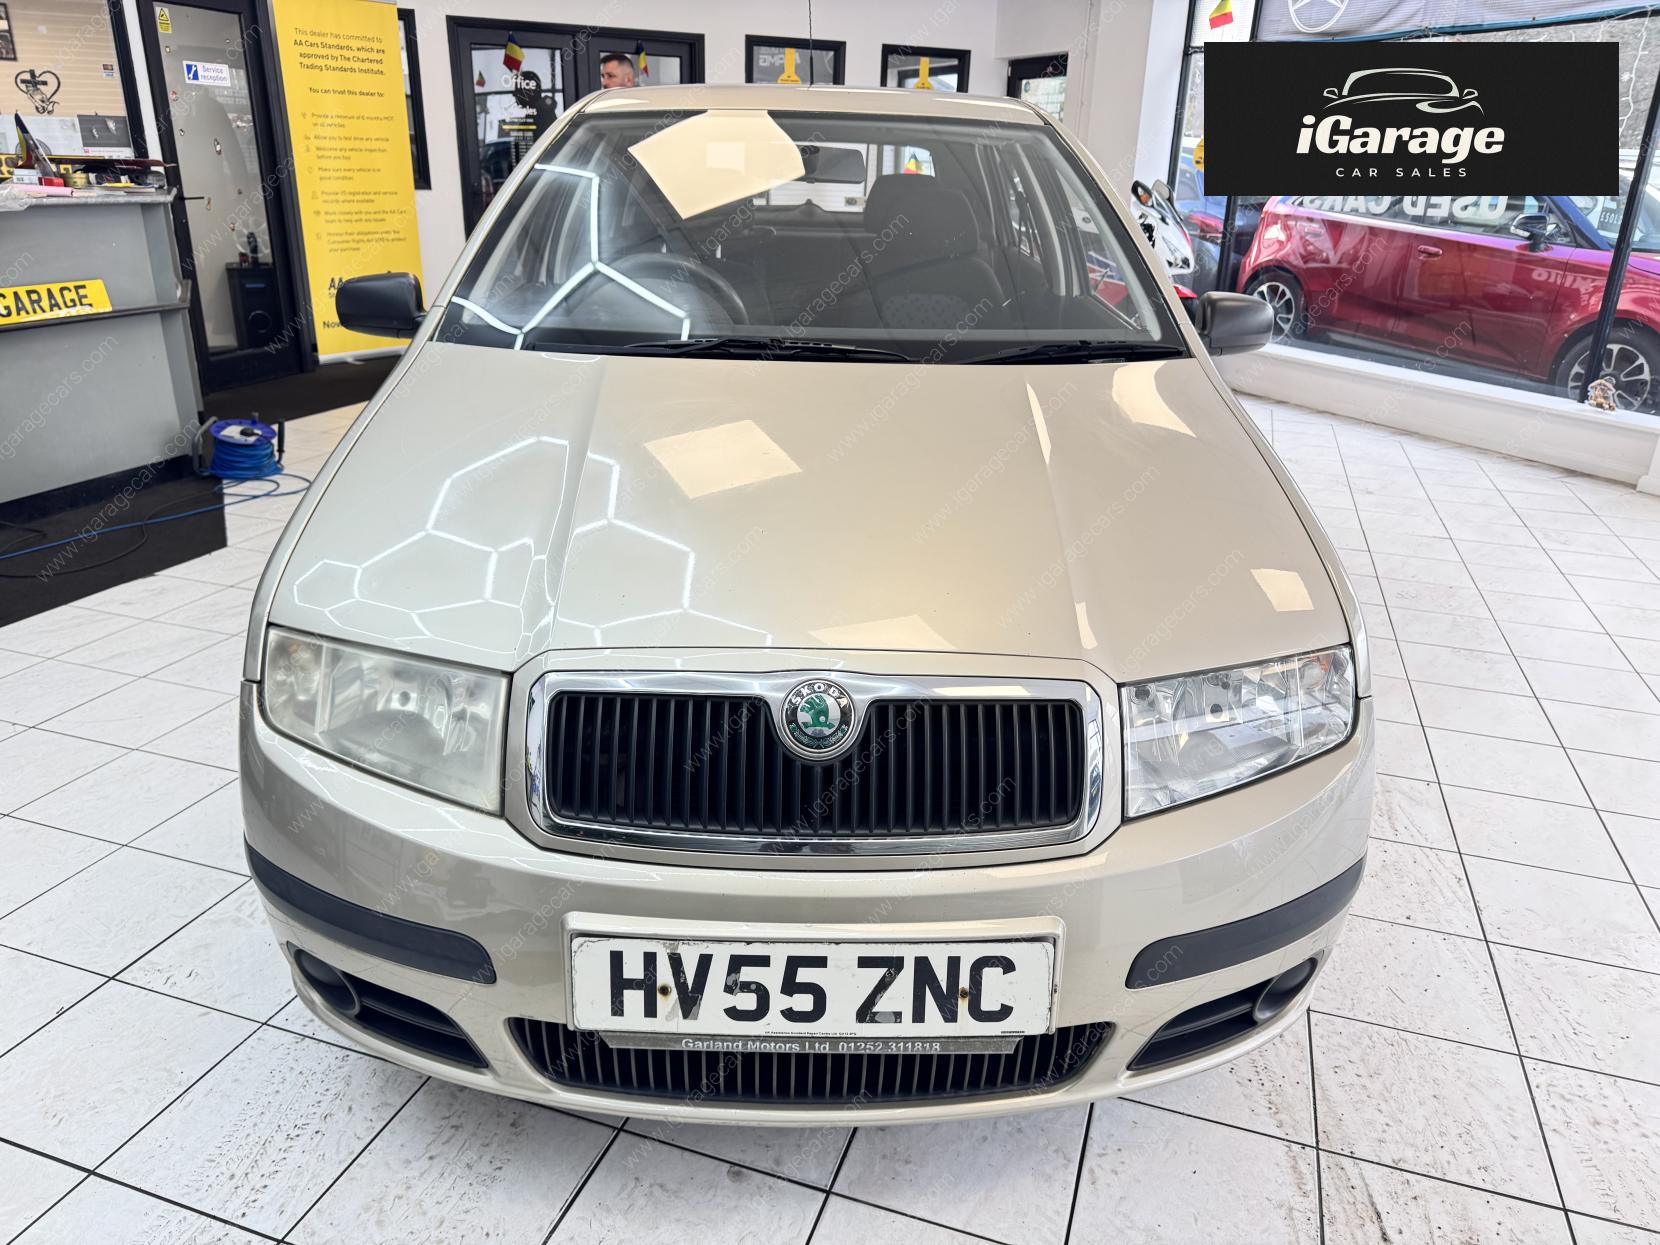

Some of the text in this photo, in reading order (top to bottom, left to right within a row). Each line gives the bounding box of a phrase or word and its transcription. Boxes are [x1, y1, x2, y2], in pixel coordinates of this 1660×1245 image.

[304, 40, 319, 48] Cars
[321, 42, 355, 51] Standards,
[356, 45, 375, 53] which
[299, 52, 329, 60] approved
[352, 56, 383, 64] Chartered
[202, 65, 224, 74] Service
[299, 62, 385, 75] Trading Standards Institute.
[200, 74, 228, 83] reception
[502, 75, 537, 89] Office
[0, 284, 93, 317] GARAGE
[609, 950, 1016, 1024] HV55 ZNC
[681, 1038, 742, 1051] Garland
[747, 1040, 800, 1052] Motors
[805, 1041, 830, 1052] Ltd
